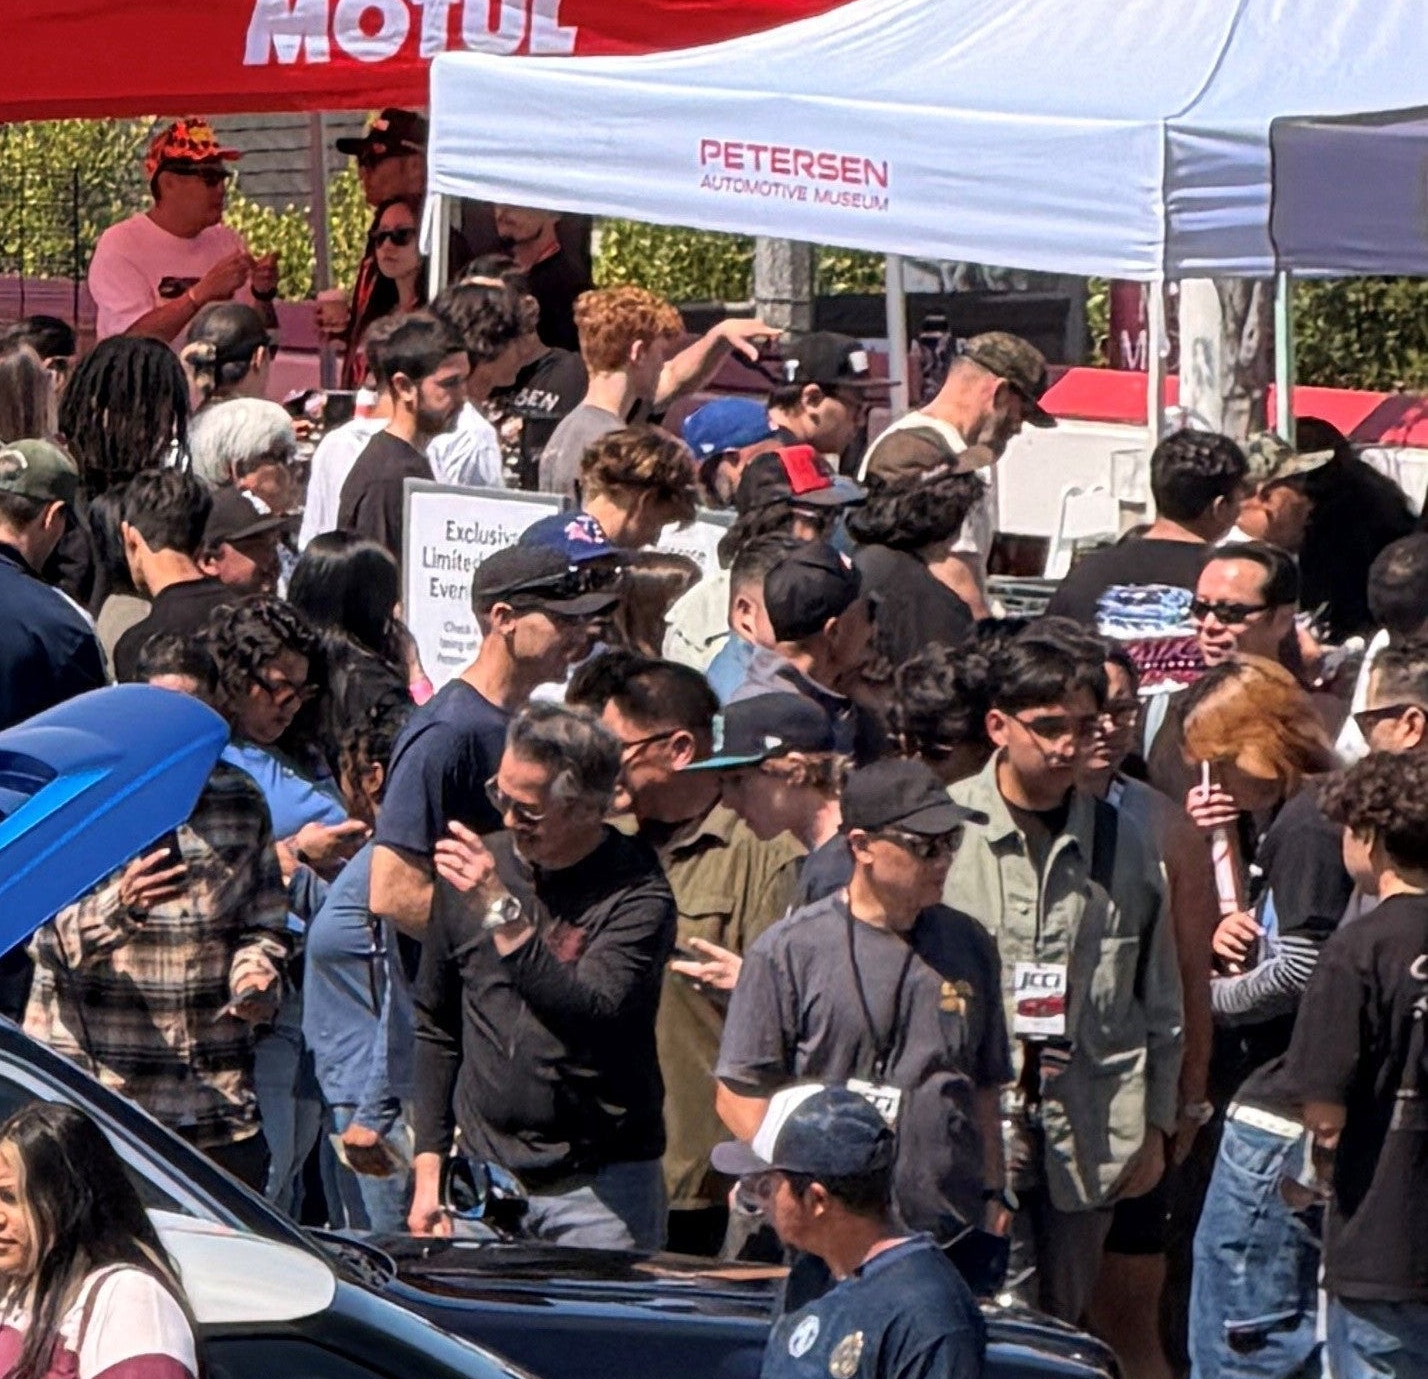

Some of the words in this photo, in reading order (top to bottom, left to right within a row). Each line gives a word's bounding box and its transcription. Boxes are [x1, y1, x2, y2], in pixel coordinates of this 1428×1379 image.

[700, 138, 889, 188] PETERSEN
[700, 174, 808, 203] AUTOMOTIVE
[814, 187, 890, 212] MUSEUM
